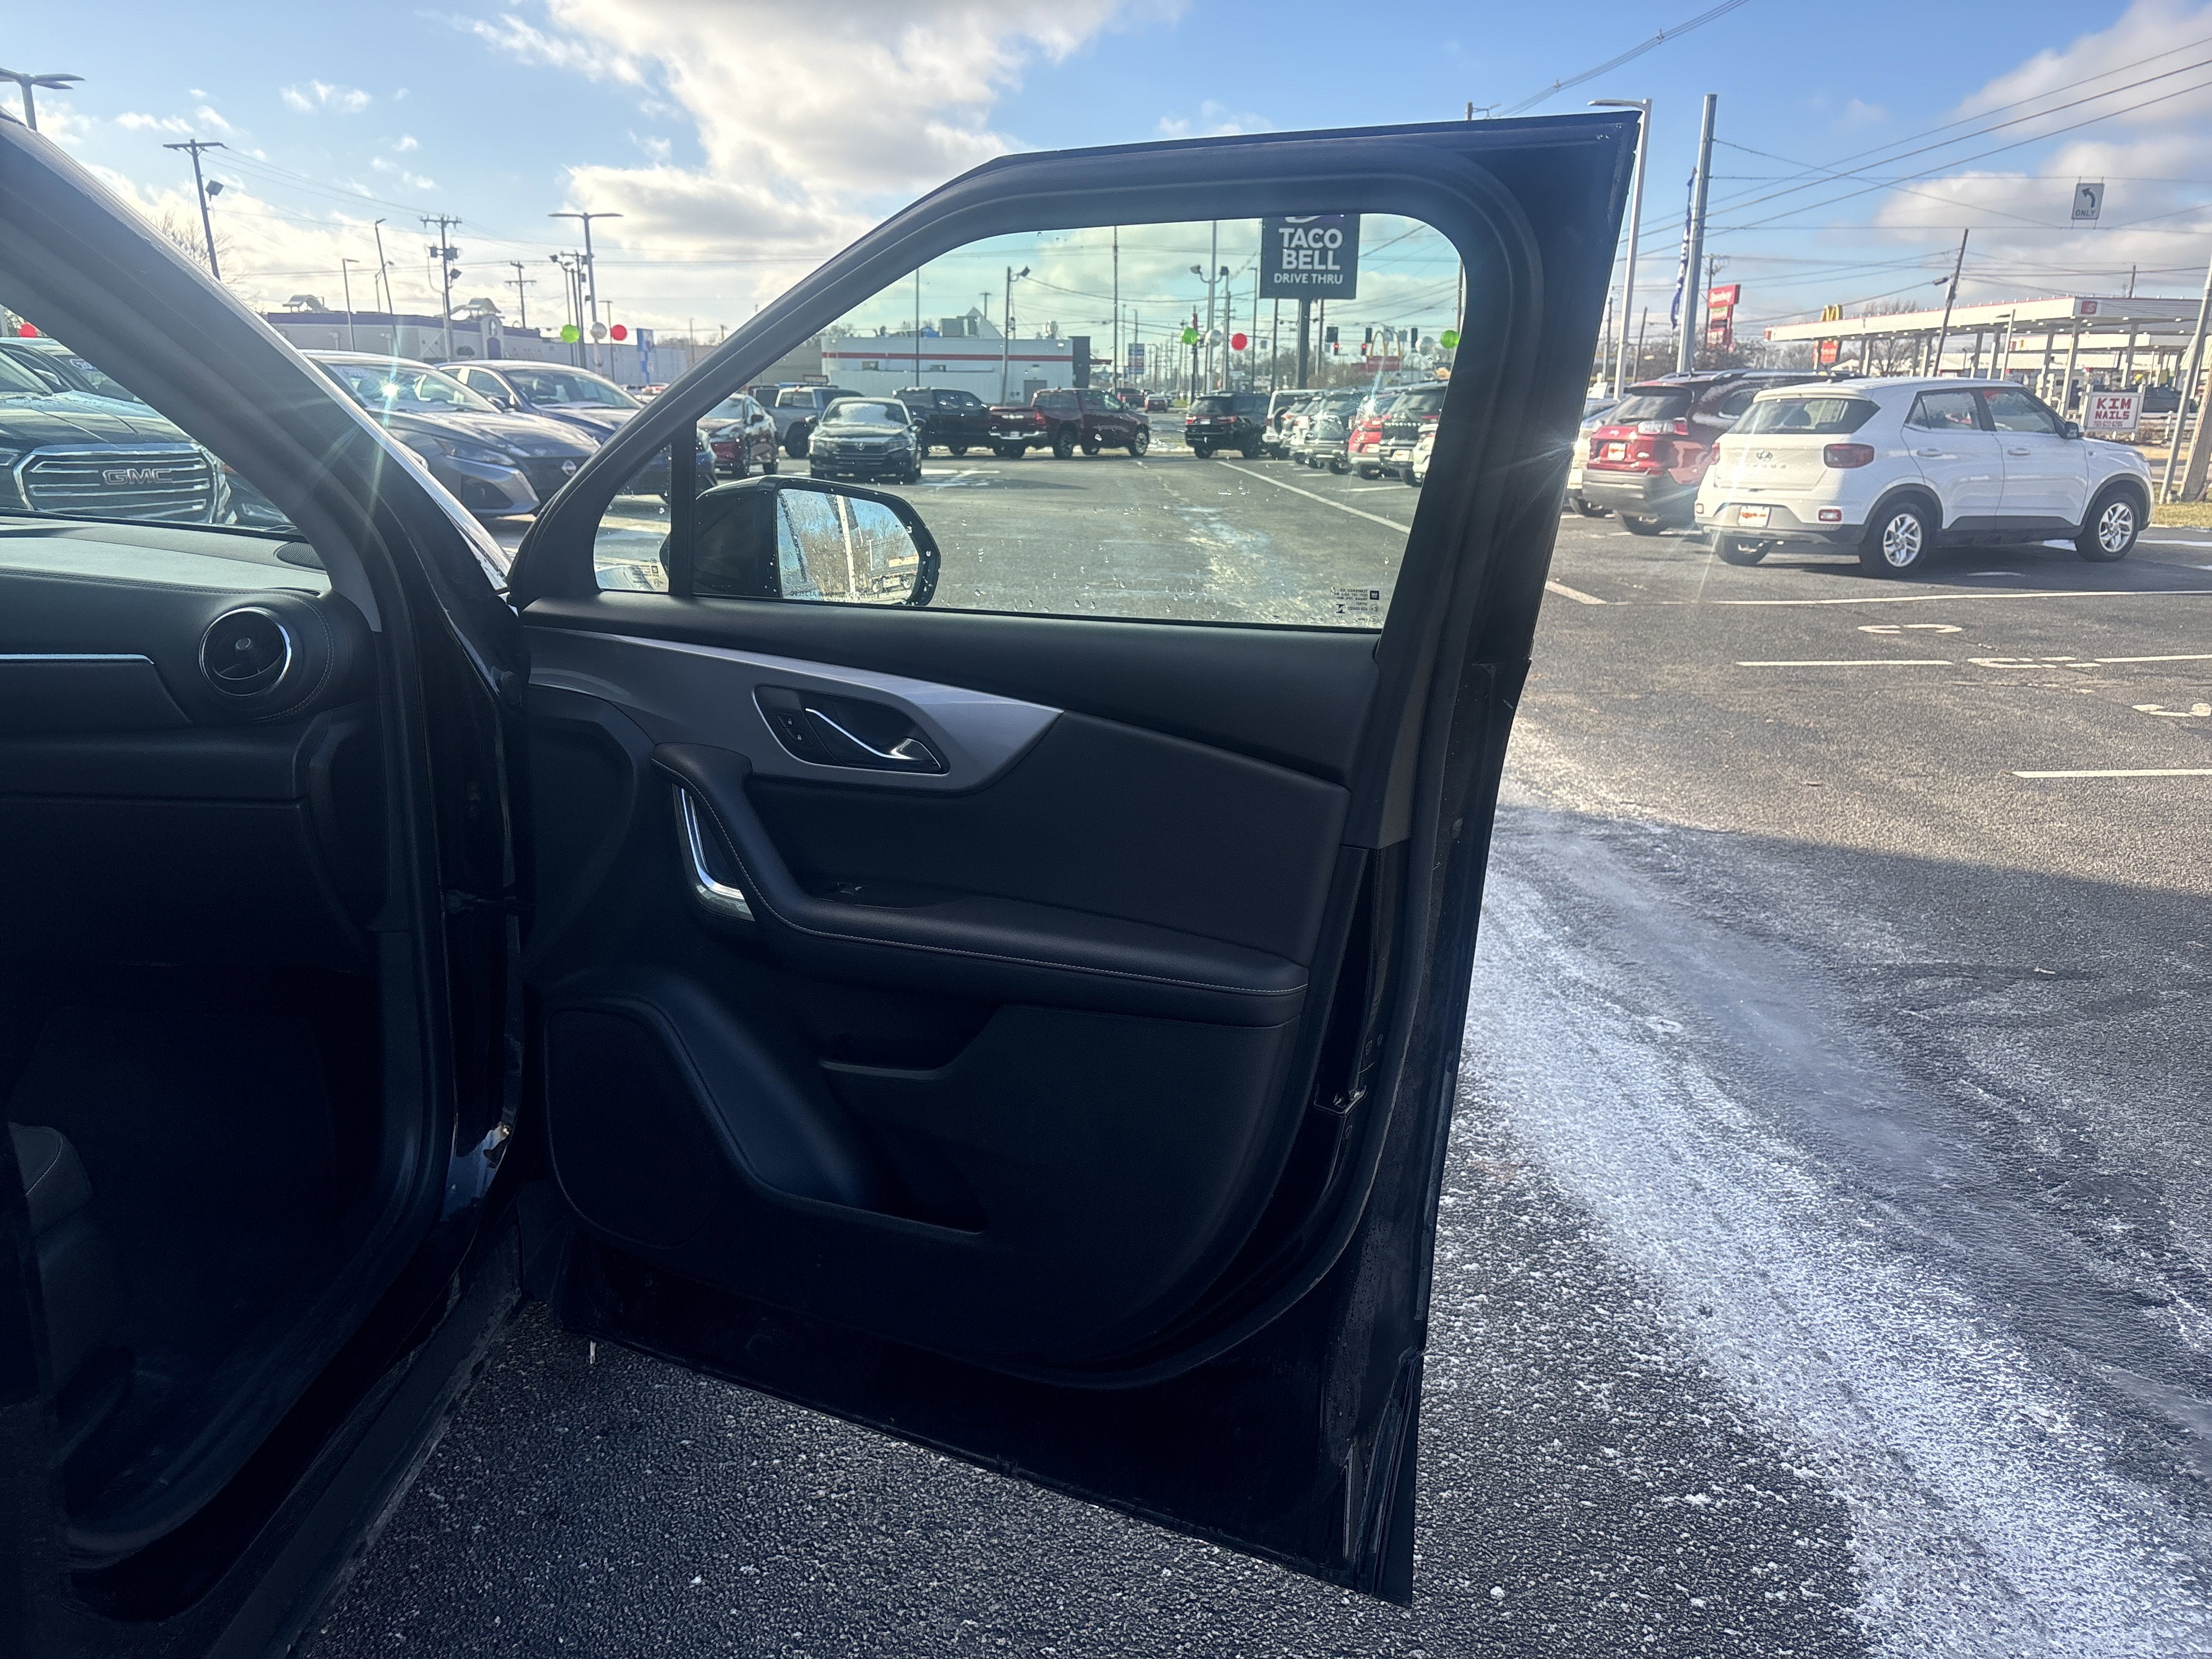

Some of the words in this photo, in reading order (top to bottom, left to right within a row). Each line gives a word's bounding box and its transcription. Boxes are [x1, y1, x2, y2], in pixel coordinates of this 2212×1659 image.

[1278, 228, 1343, 249] TACO
[1282, 250, 1341, 270] BELL
[1274, 273, 1308, 284] DRIVE
[1312, 274, 1344, 284] THRU
[2096, 398, 2132, 409] KIM
[2095, 410, 2130, 420] NAILS
[102, 468, 172, 486] GMC
